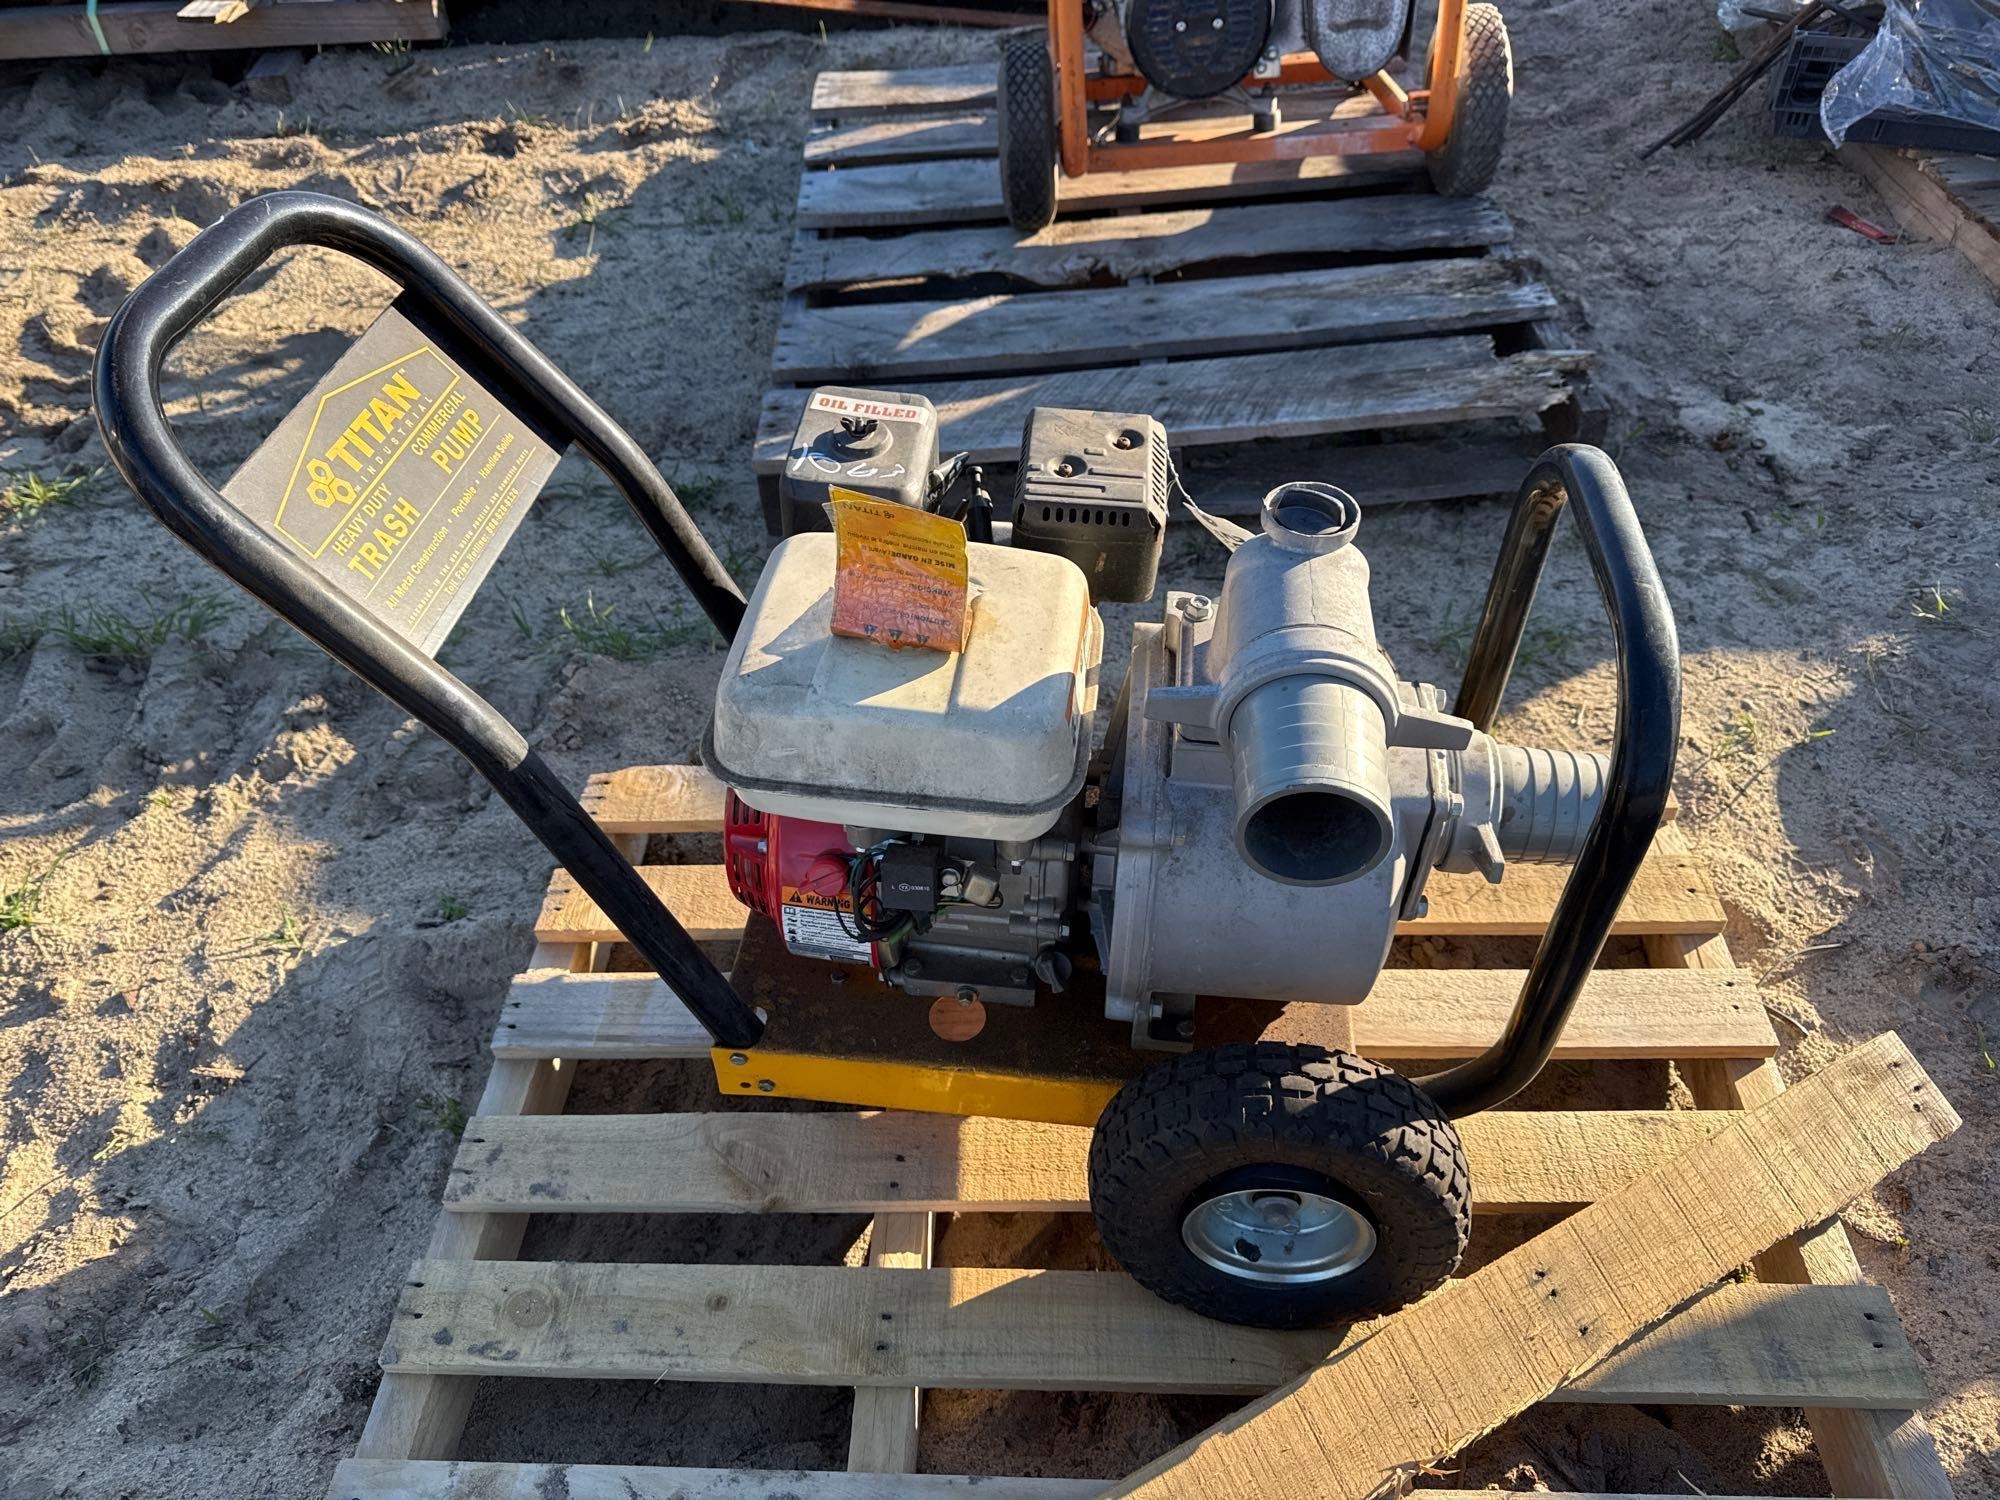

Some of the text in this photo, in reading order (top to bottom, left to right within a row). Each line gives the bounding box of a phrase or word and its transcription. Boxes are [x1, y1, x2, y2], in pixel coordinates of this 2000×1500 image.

[324, 371, 422, 479] TITAN
[359, 393, 433, 484] INDUSTRIAL
[819, 397, 918, 420] OIL FILLED
[330, 387, 467, 558] HEAVY DUTY COMMERCIAL
[346, 405, 488, 584] TRASH PUMP
[841, 500, 881, 517] TITAN
[383, 429, 515, 611] All Metal Construction Portable Handles Solids
[453, 559, 471, 581] Free
[806, 895, 851, 909] WARNNG
